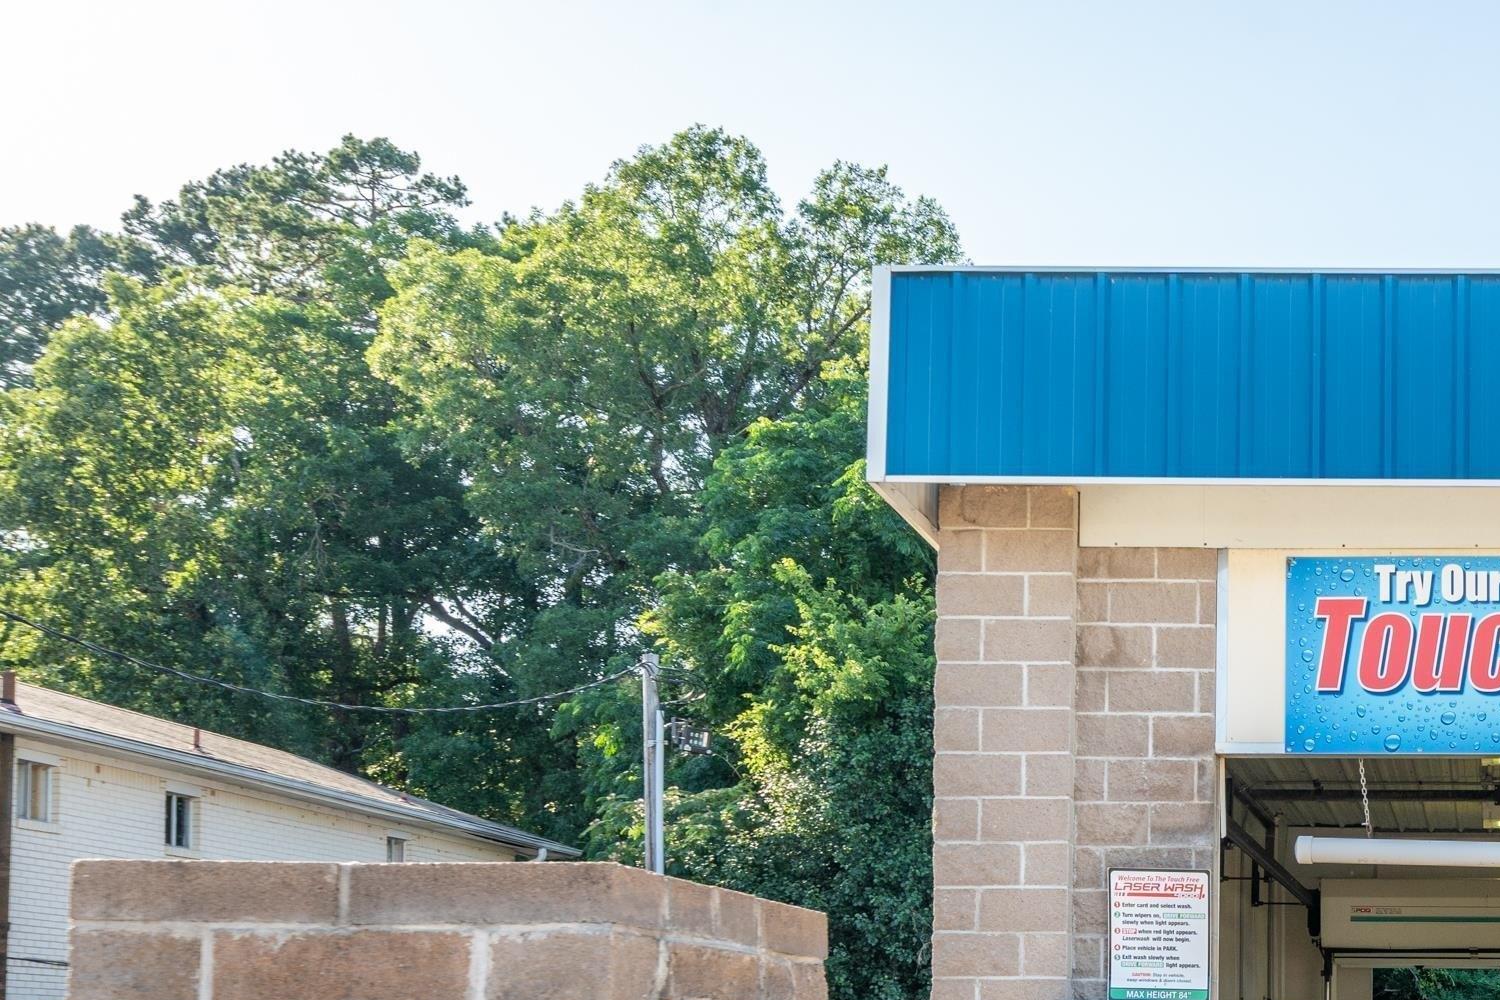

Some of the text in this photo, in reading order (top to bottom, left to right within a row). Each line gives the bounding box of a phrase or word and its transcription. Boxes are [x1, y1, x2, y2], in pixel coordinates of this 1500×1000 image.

[1374, 564, 1433, 606] Try
[1114, 882, 1204, 899] LASER WASH
[1146, 991, 1177, 999] HEIGHT
[1178, 991, 1192, 999] 84"
